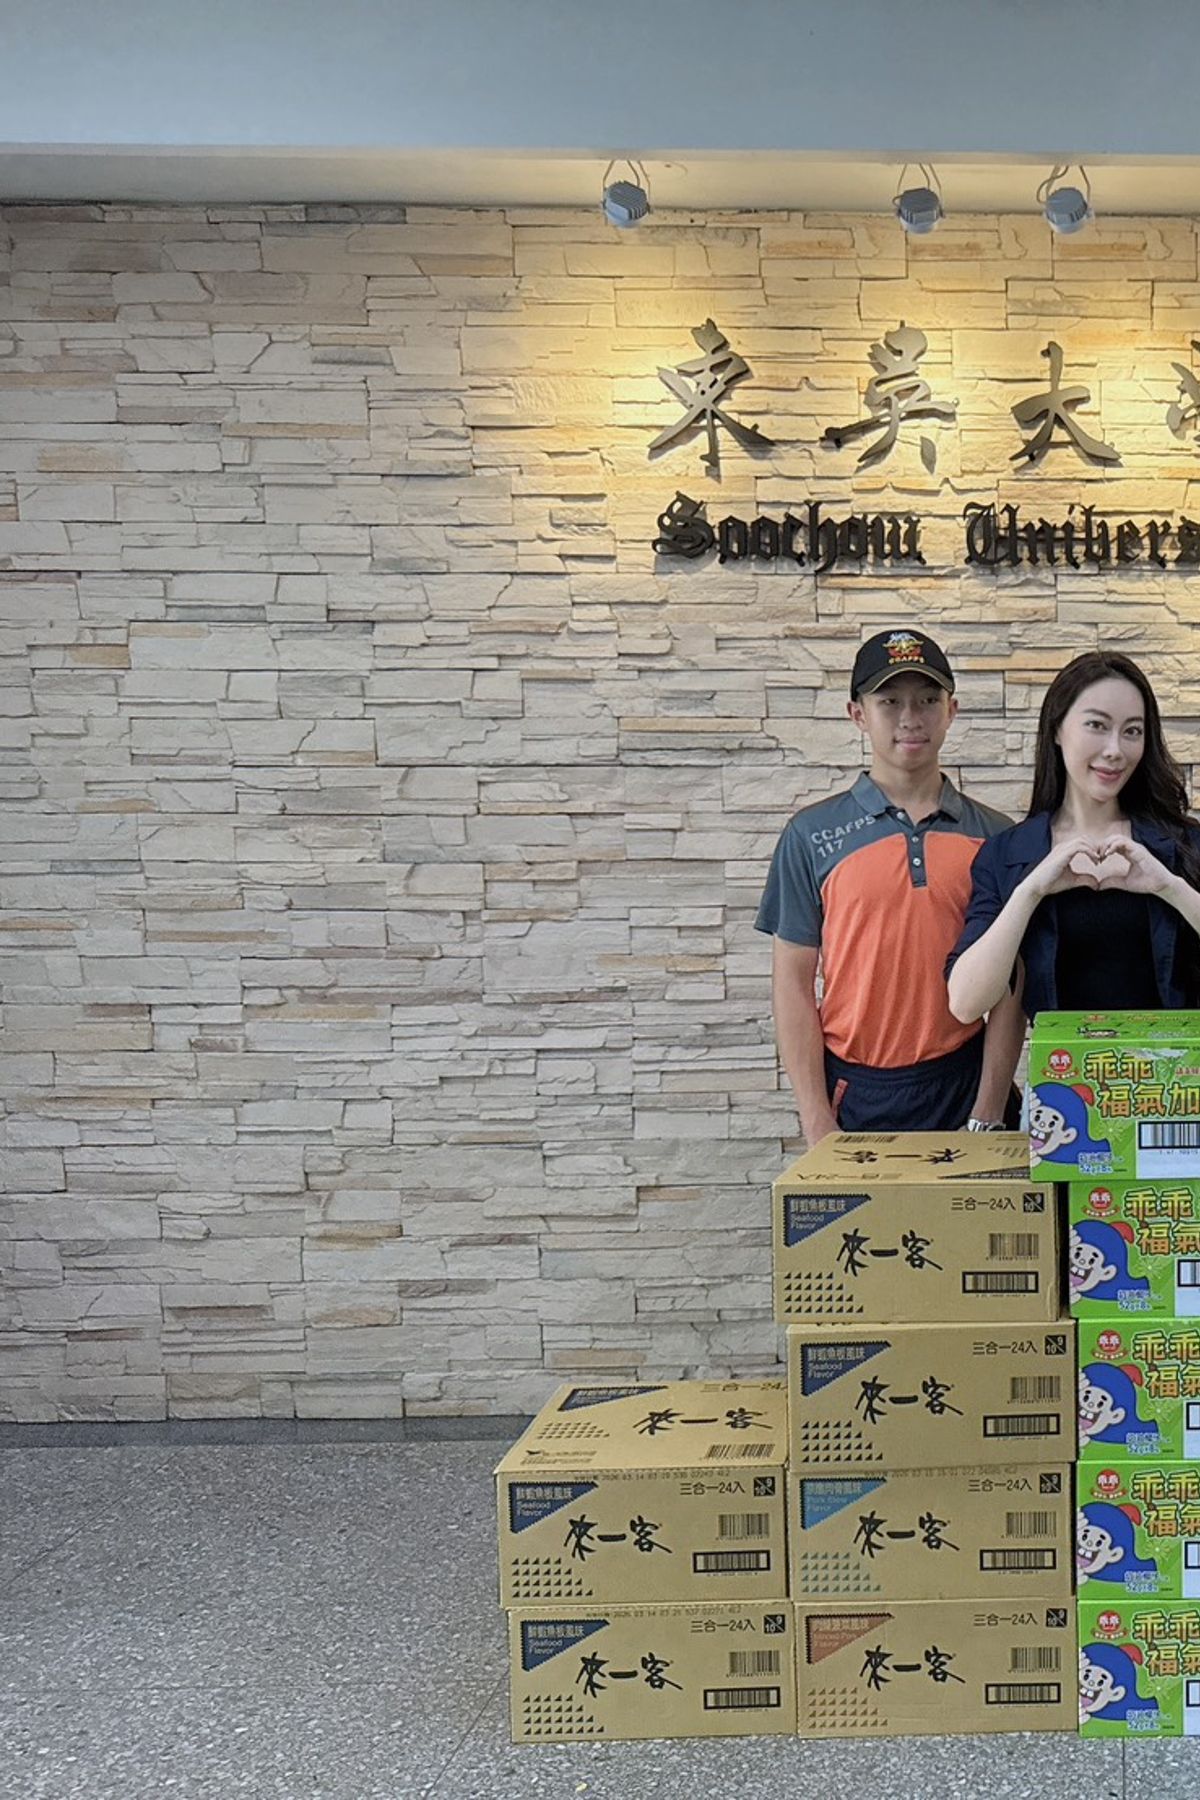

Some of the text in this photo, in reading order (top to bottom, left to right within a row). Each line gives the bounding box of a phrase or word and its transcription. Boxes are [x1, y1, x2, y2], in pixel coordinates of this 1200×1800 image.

[652, 492, 924, 573] Soochow
[810, 814, 877, 845] CCAFPS
[817, 839, 844, 859] 117
[1083, 1049, 1154, 1083] 乖乖
[1125, 1188, 1194, 1221] 乖乖
[836, 1228, 944, 1277] 來一客
[633, 1407, 773, 1435] 來一客
[855, 1376, 964, 1425] 來一客
[1132, 1470, 1200, 1503] 乖乖
[563, 1514, 672, 1561] 來一客
[853, 1510, 960, 1559] 來一客
[576, 1651, 683, 1698] 來一客
[860, 1644, 966, 1691] 來一客
